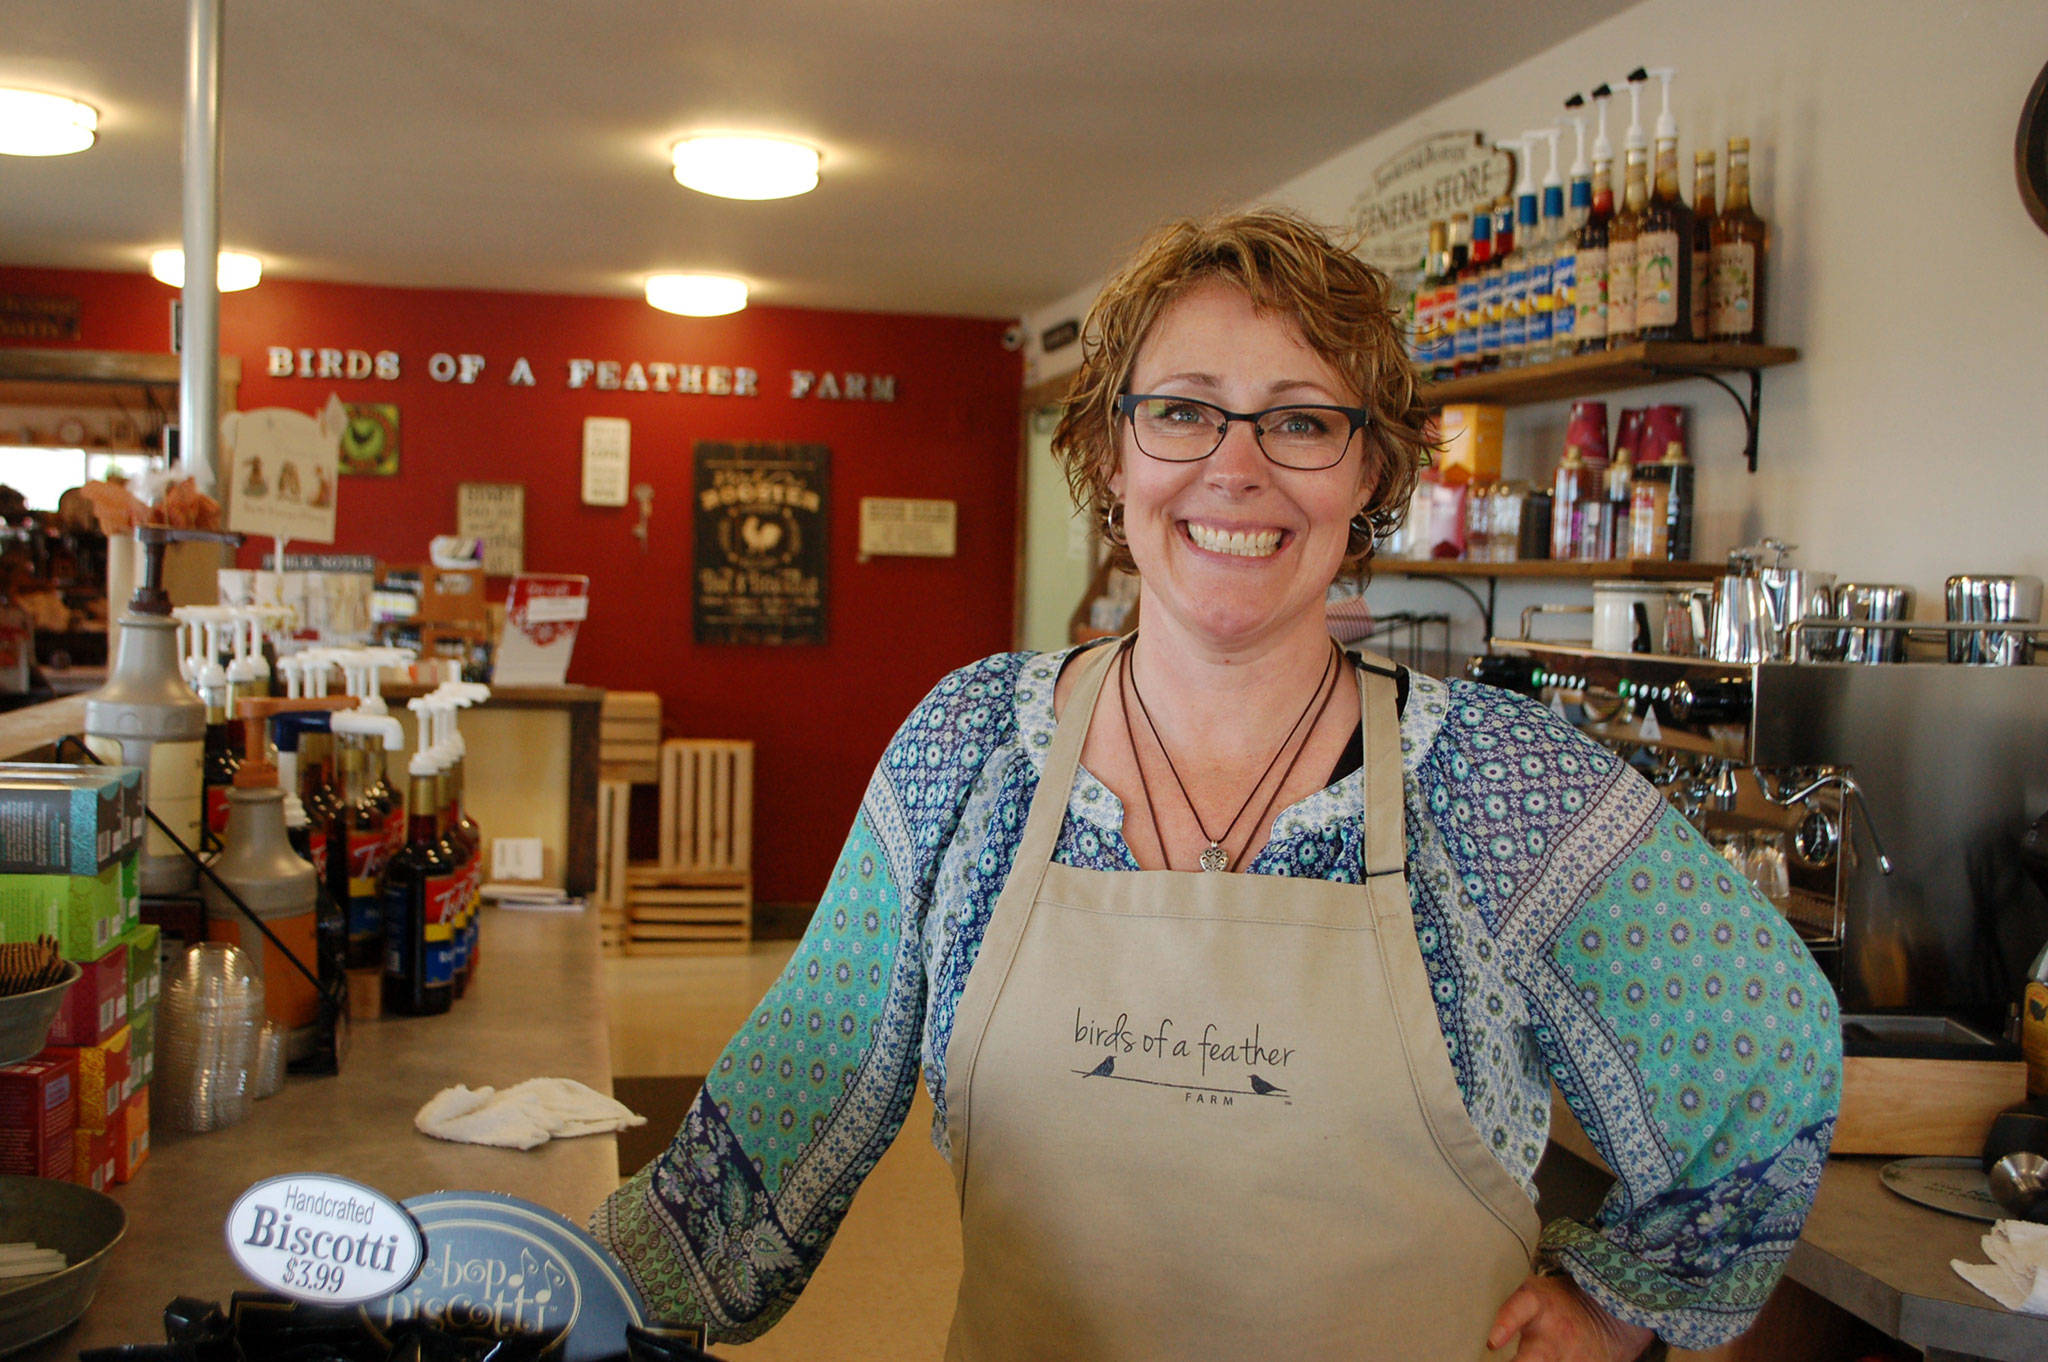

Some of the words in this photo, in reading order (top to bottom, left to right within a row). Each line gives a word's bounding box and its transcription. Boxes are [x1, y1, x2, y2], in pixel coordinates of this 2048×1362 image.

[268, 346, 400, 380] BIRDS
[428, 353, 485, 384] OF
[508, 356, 537, 387] A
[567, 359, 758, 397] FEATHER
[790, 369, 896, 402] FARM
[1074, 1007, 1137, 1054] birds
[1143, 1018, 1174, 1059] of
[1172, 1039, 1191, 1058] a
[1197, 1023, 1296, 1077] feather
[1184, 1092, 1234, 1106] FARM
[284, 1183, 376, 1226] Handcrafted
[243, 1203, 400, 1274] Biscotti
[282, 1255, 346, 1294] $3.99
